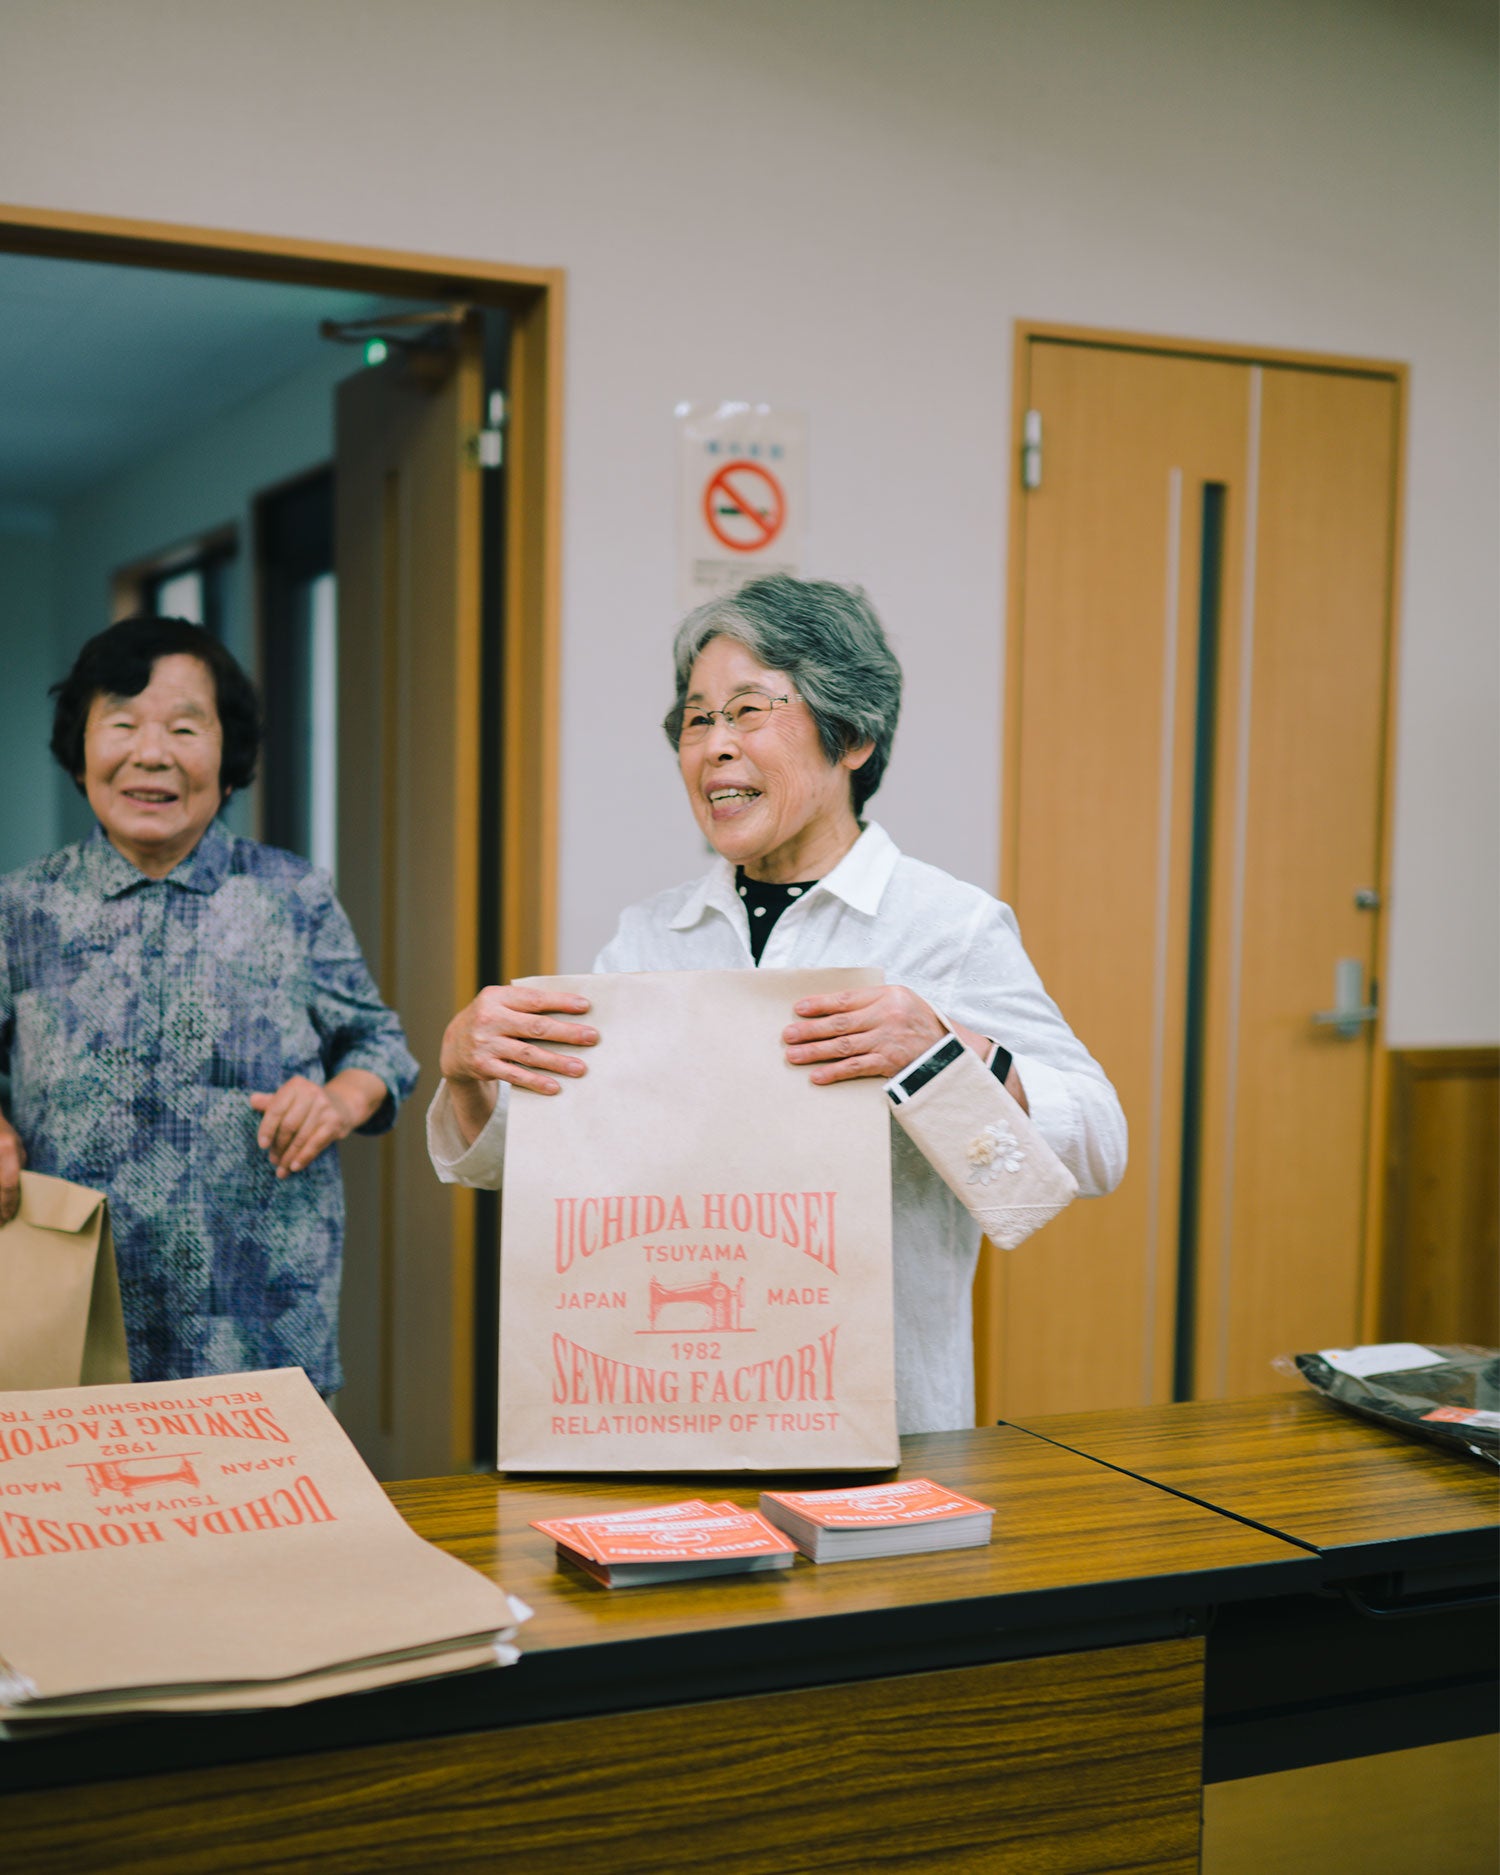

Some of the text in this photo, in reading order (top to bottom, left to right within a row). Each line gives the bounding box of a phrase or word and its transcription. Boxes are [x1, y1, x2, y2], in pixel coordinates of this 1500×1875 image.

[553, 1191, 839, 1276] UCHIDA HOUSEI
[643, 1244, 747, 1262] TSUYAMA
[556, 1292, 627, 1310] JAPAN
[767, 1287, 830, 1305] MADE
[671, 1342, 722, 1360] 1982
[552, 1325, 840, 1405] SEWING FACTORY
[82, 1391, 264, 1417] RELATIONSHIP
[42, 1408, 74, 1421] OF
[551, 1412, 840, 1435] RELATIONSHIP OF TRUST
[136, 1407, 291, 1443] SEWING
[99, 1441, 158, 1456] 1982
[220, 1455, 298, 1475] JAPAN
[0, 1481, 63, 1496] MAD
[96, 1494, 219, 1517] TSUYAMA
[173, 1475, 338, 1539] UCHIDA
[693, 1539, 769, 1554] UCHIDA
